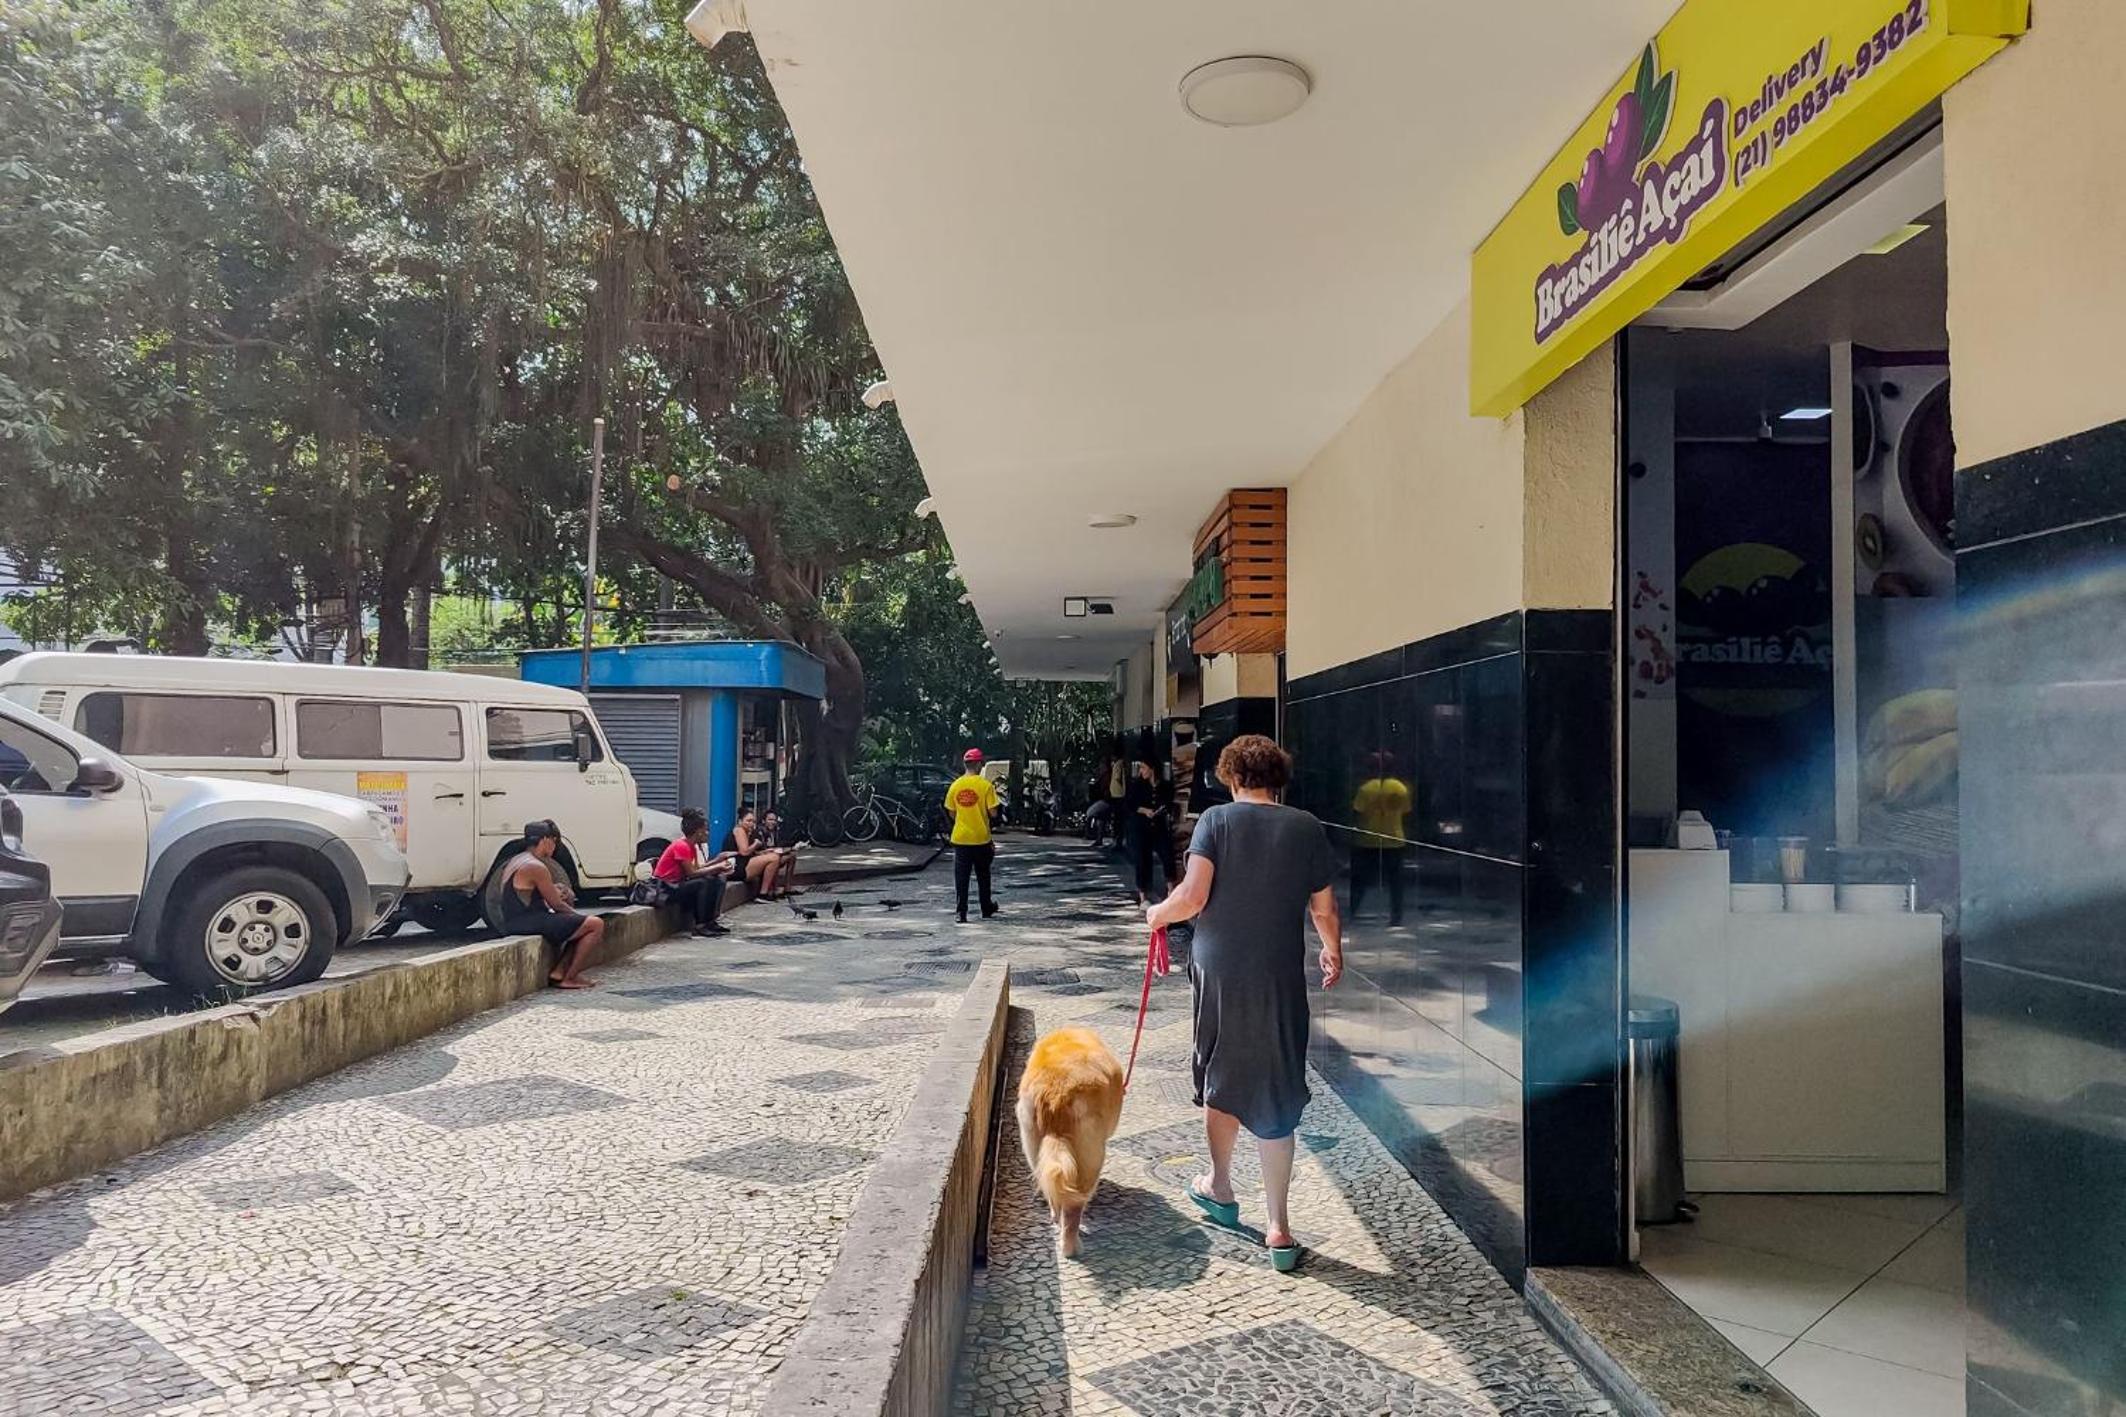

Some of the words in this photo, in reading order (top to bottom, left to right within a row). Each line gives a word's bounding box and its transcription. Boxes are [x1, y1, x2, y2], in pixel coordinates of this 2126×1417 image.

[1734, 37, 1826, 139] Delivery
[1734, 130, 1768, 188] (21)
[1773, 0, 1923, 150] 98834-9382
[1537, 198, 1635, 334] Brasiliê
[1635, 117, 1715, 246] Açaí
[1676, 635, 1783, 663] rasiliê
